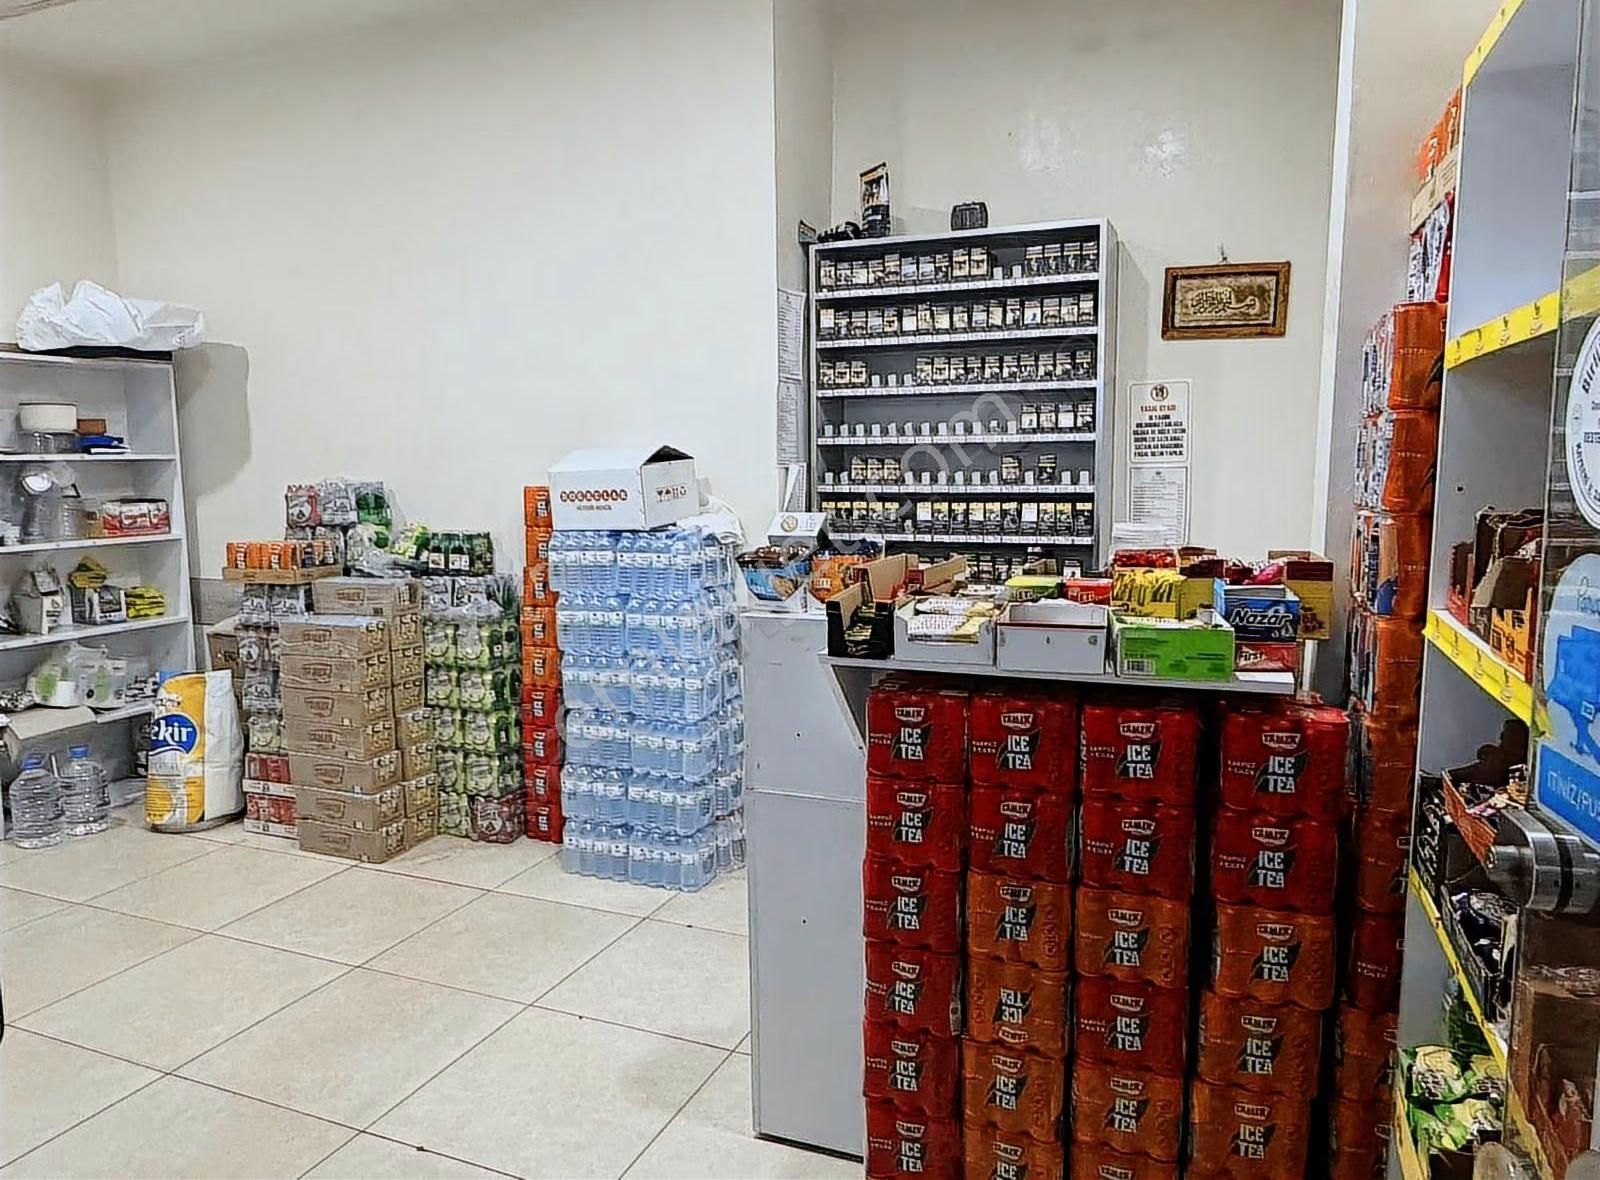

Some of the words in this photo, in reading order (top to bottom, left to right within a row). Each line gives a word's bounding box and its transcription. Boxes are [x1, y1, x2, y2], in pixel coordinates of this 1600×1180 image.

[1230, 608, 1292, 627] Nazar
[901, 727, 922, 743] ICE
[1007, 735, 1030, 752] ICE
[900, 744, 924, 760] TEA
[1126, 744, 1152, 762] ICE
[1006, 753, 1032, 770] TEA
[1268, 755, 1295, 774] ICE
[1126, 763, 1153, 779] TEA
[1267, 775, 1296, 793] TEA
[902, 812, 922, 826] ICE
[901, 827, 922, 843] TEA
[1004, 822, 1026, 840] ICE
[1003, 840, 1026, 858] TEA
[1126, 838, 1150, 857] ICE
[1124, 856, 1149, 875] TEA
[1258, 850, 1284, 869] ICE
[1257, 870, 1284, 888] TEA
[897, 896, 918, 912] ICE
[896, 912, 920, 930] TEA
[1005, 906, 1026, 924] ICE
[1004, 924, 1028, 941] TEA
[1114, 930, 1138, 949] ICE
[1114, 949, 1140, 966] TEA
[1263, 946, 1288, 963] ICE
[1262, 964, 1288, 982] TEA
[895, 981, 916, 999] ICE
[1000, 988, 1024, 1006] TEA
[894, 996, 915, 1014] TEA
[1002, 1006, 1022, 1024] ICE
[1116, 1016, 1140, 1034] ICE
[1116, 1033, 1142, 1051] TEA
[1246, 1038, 1272, 1056] ICE
[896, 1060, 916, 1076] ICE
[1246, 1056, 1272, 1074] TEA
[896, 1075, 917, 1092] TEA
[996, 1074, 1016, 1094] ICE
[995, 1092, 1016, 1110] TEA
[1115, 1098, 1137, 1117] ICE
[1113, 1115, 1137, 1133] TEA
[1239, 1124, 1264, 1142] ICE
[901, 1140, 922, 1157] ICE
[1238, 1140, 1264, 1159] TEA
[900, 1156, 923, 1172] TEA
[997, 1160, 1018, 1178] ICE
